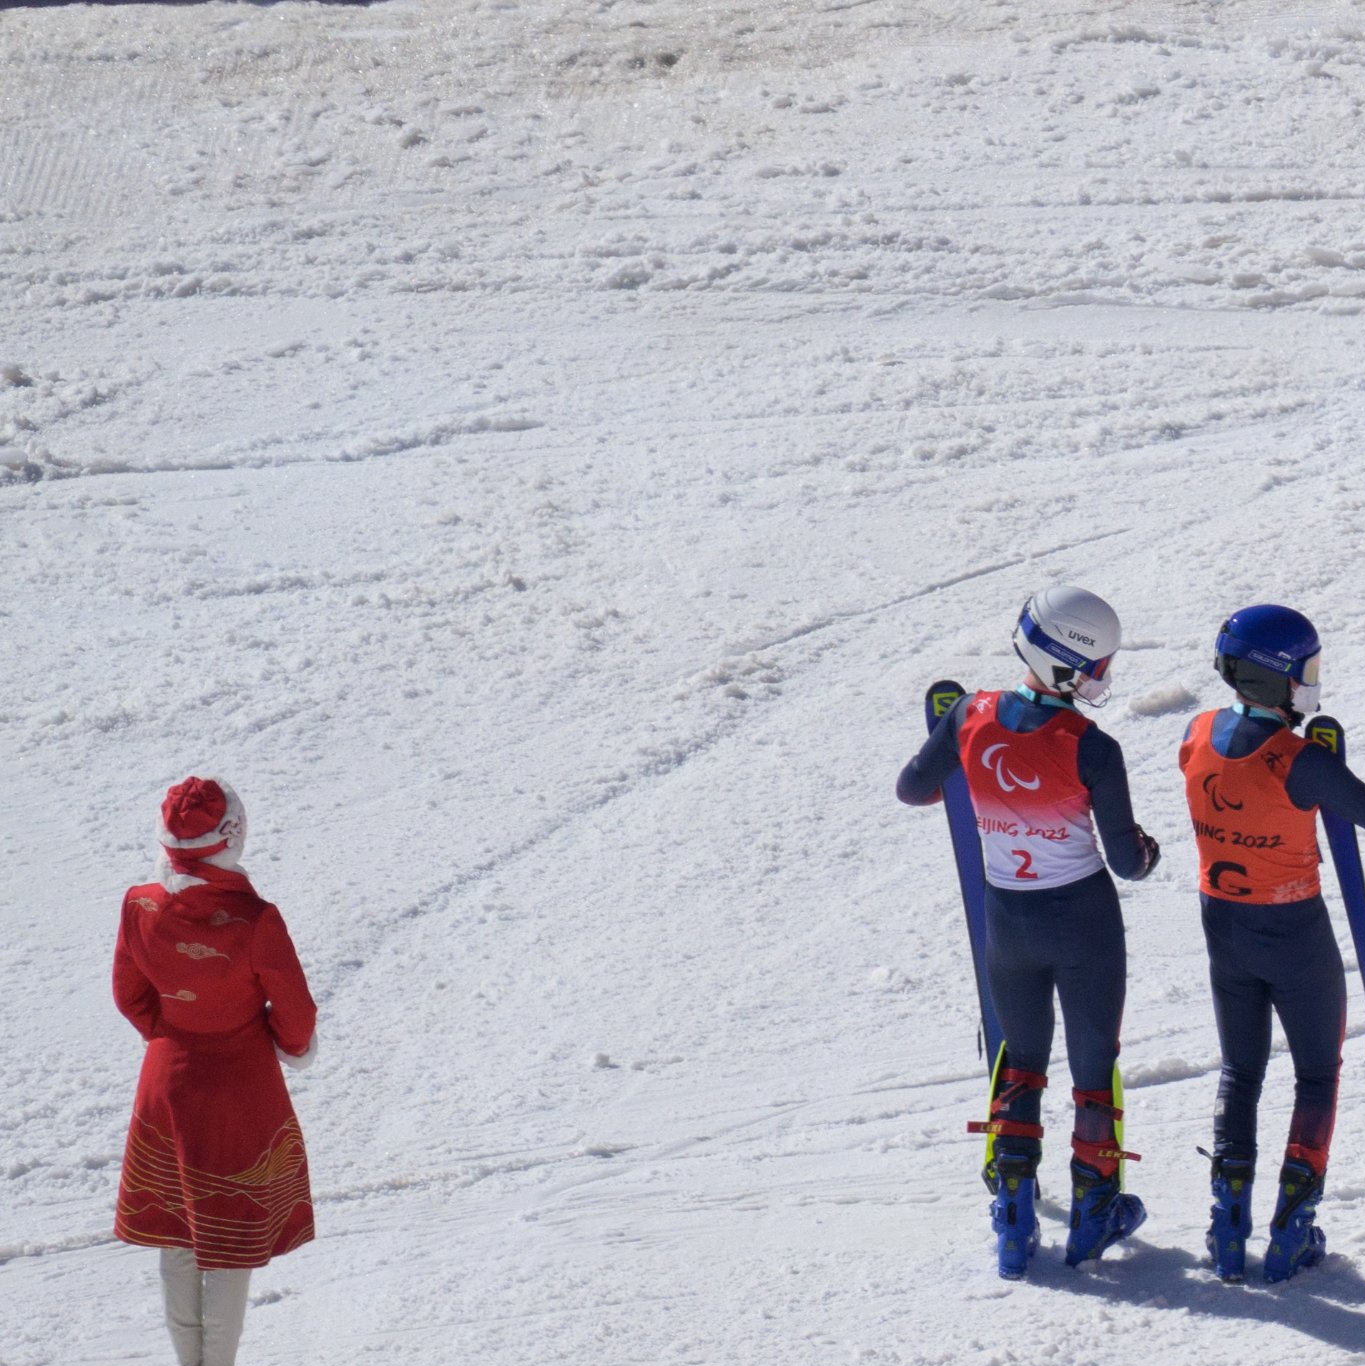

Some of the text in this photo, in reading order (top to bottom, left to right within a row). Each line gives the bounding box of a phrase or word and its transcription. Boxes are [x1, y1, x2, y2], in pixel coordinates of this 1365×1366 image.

[1068, 630, 1096, 647] uvex
[1231, 831, 1284, 849] 2022
[1011, 850, 1038, 879] 2
[1208, 861, 1252, 897] G
[1098, 1149, 1128, 1160] LEKI
